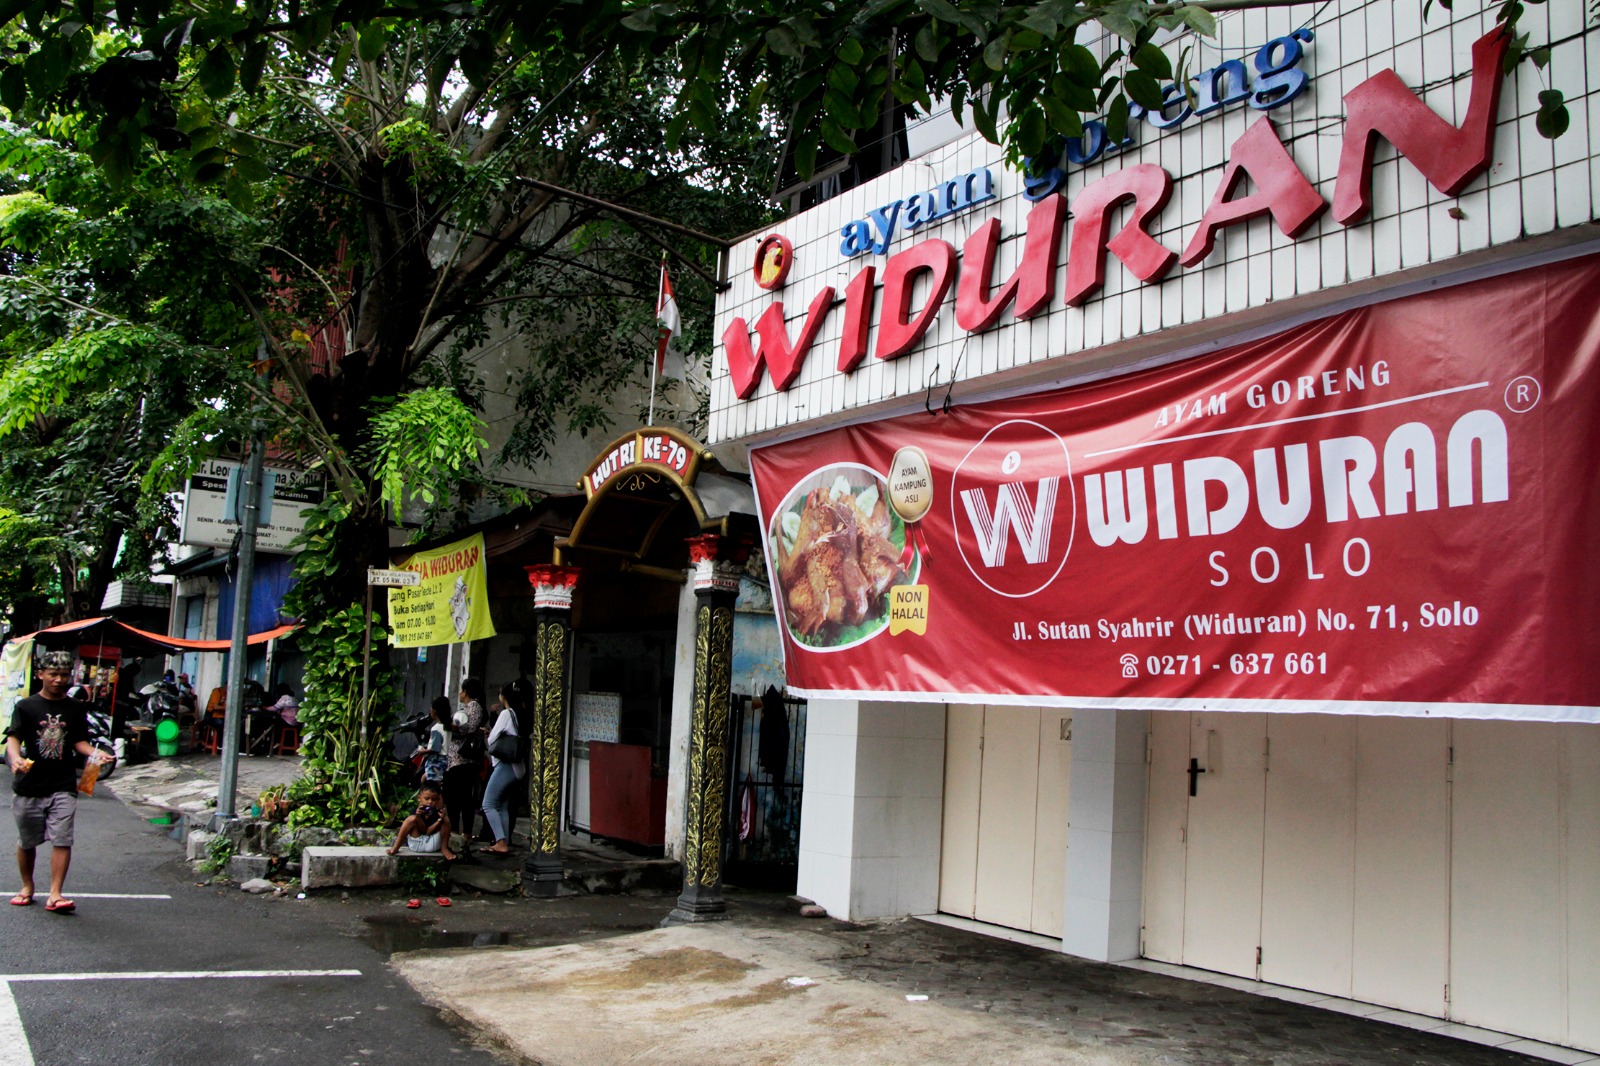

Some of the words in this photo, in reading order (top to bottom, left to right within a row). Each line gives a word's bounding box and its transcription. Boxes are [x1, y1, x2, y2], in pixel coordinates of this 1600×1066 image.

[722, 25, 1509, 401] WIDURAN
[838, 166, 995, 257] ayam
[1154, 391, 1227, 429] AYAM
[1247, 360, 1391, 409] GORENG
[591, 449, 619, 490] HUT
[620, 440, 636, 467] RI
[643, 437, 687, 470] KE-79
[901, 466, 917, 478] AYAM
[894, 478, 927, 492] KAMPUNG
[1084, 409, 1509, 547] WIDURAN
[904, 494, 919, 504] ASLI
[430, 546, 479, 577] WIDURAN
[1210, 537, 1371, 587] SOLO
[439, 582, 443, 593] 2
[896, 591, 922, 603] NON
[393, 606, 409, 615] Buka
[892, 607, 925, 620] HALAL
[1012, 621, 1032, 640] Jl.
[1038, 620, 1091, 640] Sutan
[1098, 617, 1174, 643] Syahrir
[1184, 610, 1306, 641] (Widuran)
[1317, 607, 1355, 633] No.
[1367, 605, 1409, 633] 71,
[1420, 600, 1479, 628] Solo
[407, 617, 421, 629] 07.00
[1146, 654, 1201, 675] 0271
[1229, 653, 1274, 675] 637
[1284, 652, 1327, 674] 661
